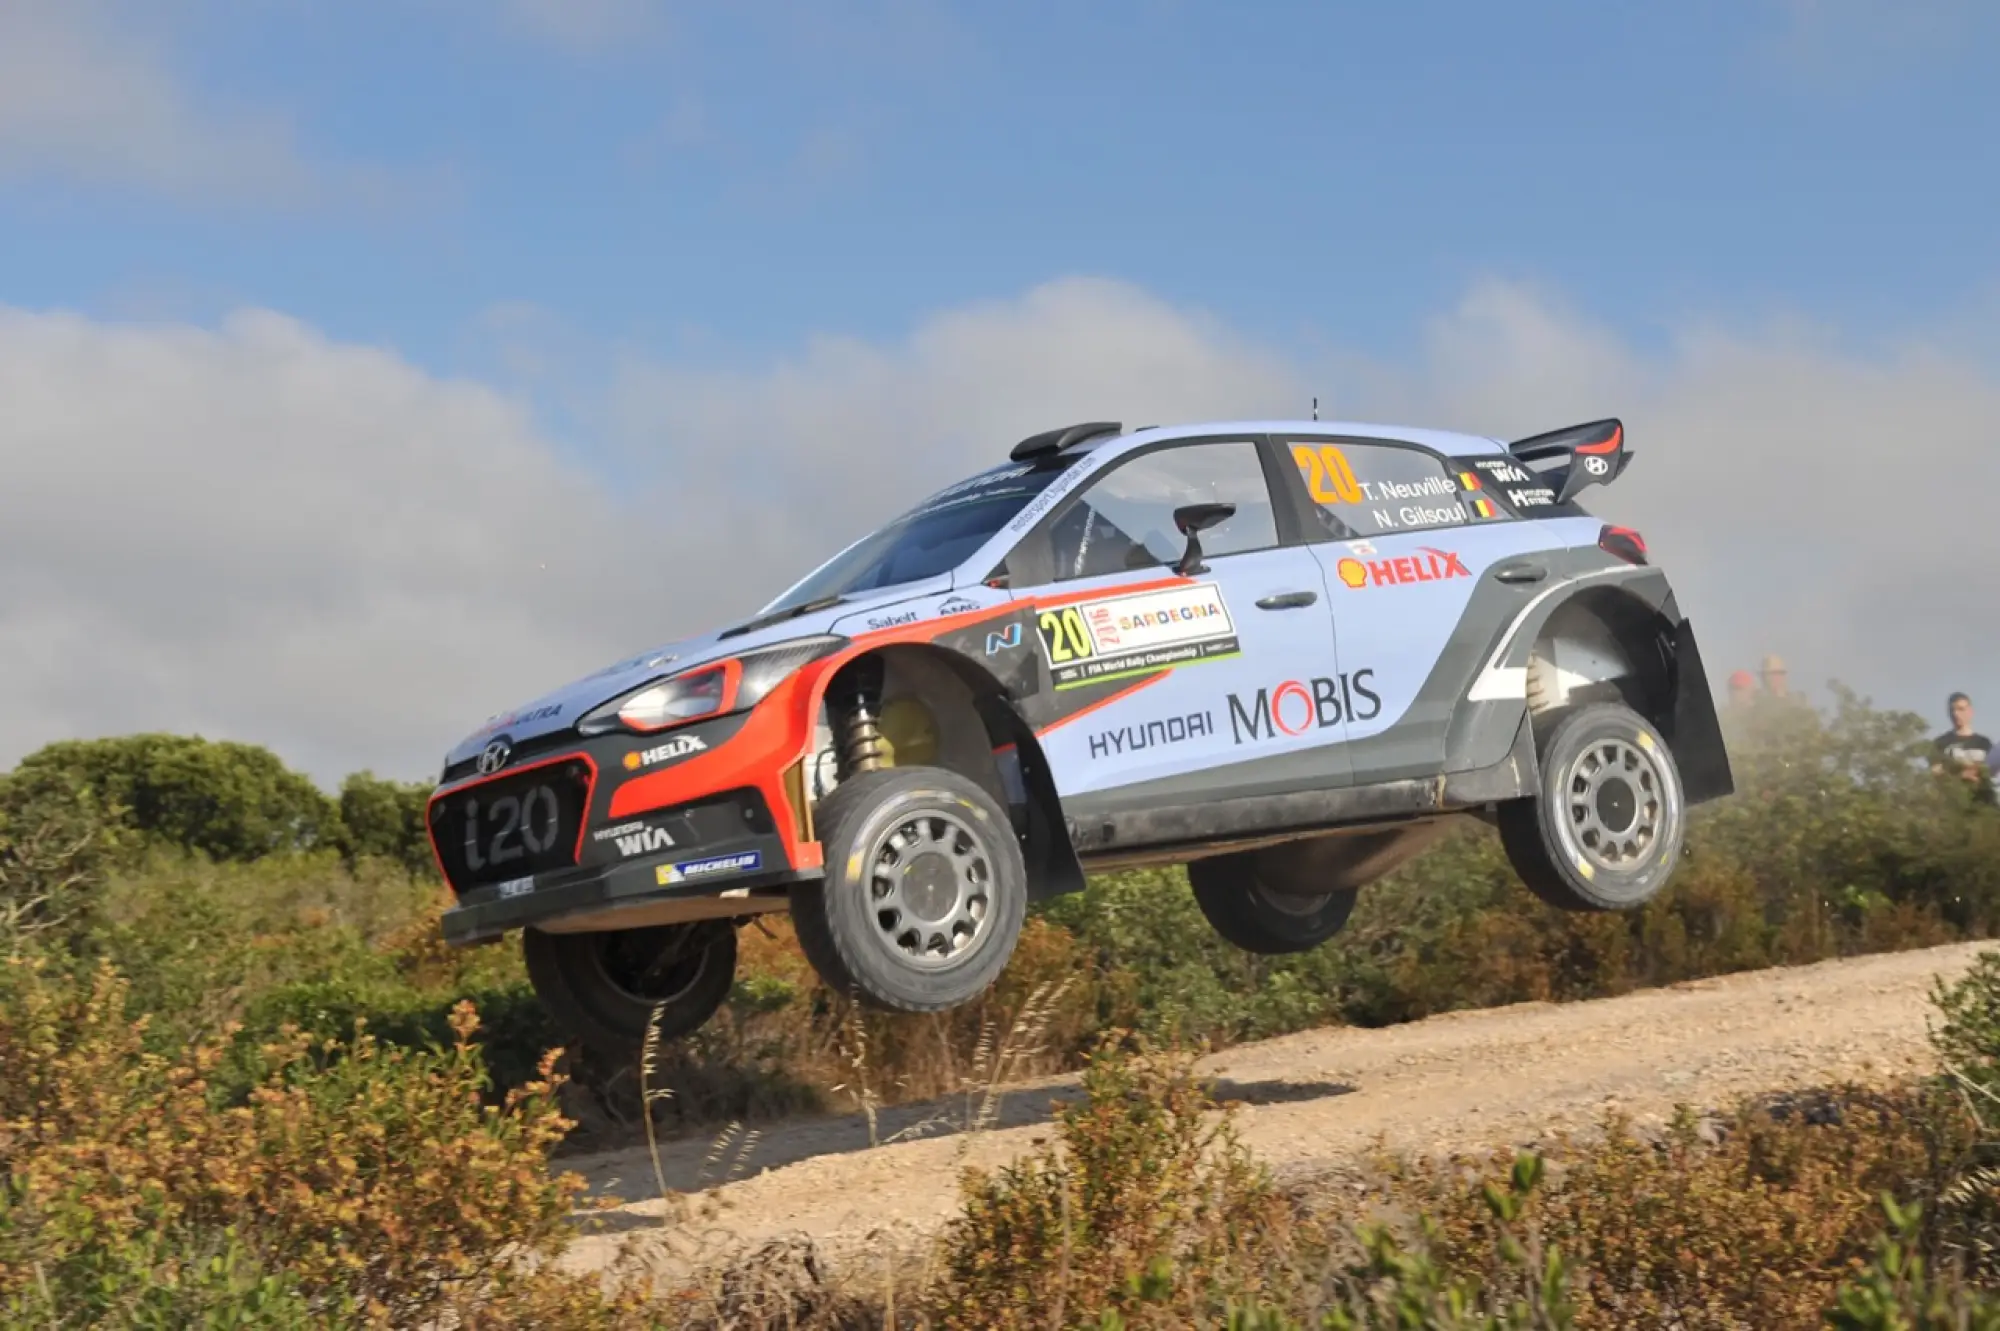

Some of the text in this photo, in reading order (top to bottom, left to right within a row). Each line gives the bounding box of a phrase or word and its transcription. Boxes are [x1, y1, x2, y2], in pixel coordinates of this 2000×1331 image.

[1293, 446, 1363, 504] 20
[1360, 476, 1456, 501] T. Neuville
[1374, 502, 1467, 529] N. Gilsoul
[1368, 548, 1472, 586] HELIX
[867, 612, 918, 630] Sabelt
[1119, 603, 1220, 630] SARDEGNA
[1039, 608, 1092, 662] 20
[1103, 660, 1125, 672] World
[1126, 657, 1145, 668] Rally
[1146, 647, 1197, 664] Championship
[1089, 668, 1381, 759] HYUNDAI MOBIS
[642, 735, 707, 766] HELIX
[465, 785, 559, 871] i20
[615, 826, 675, 857] WIA
[684, 854, 756, 875] MICHELIN
